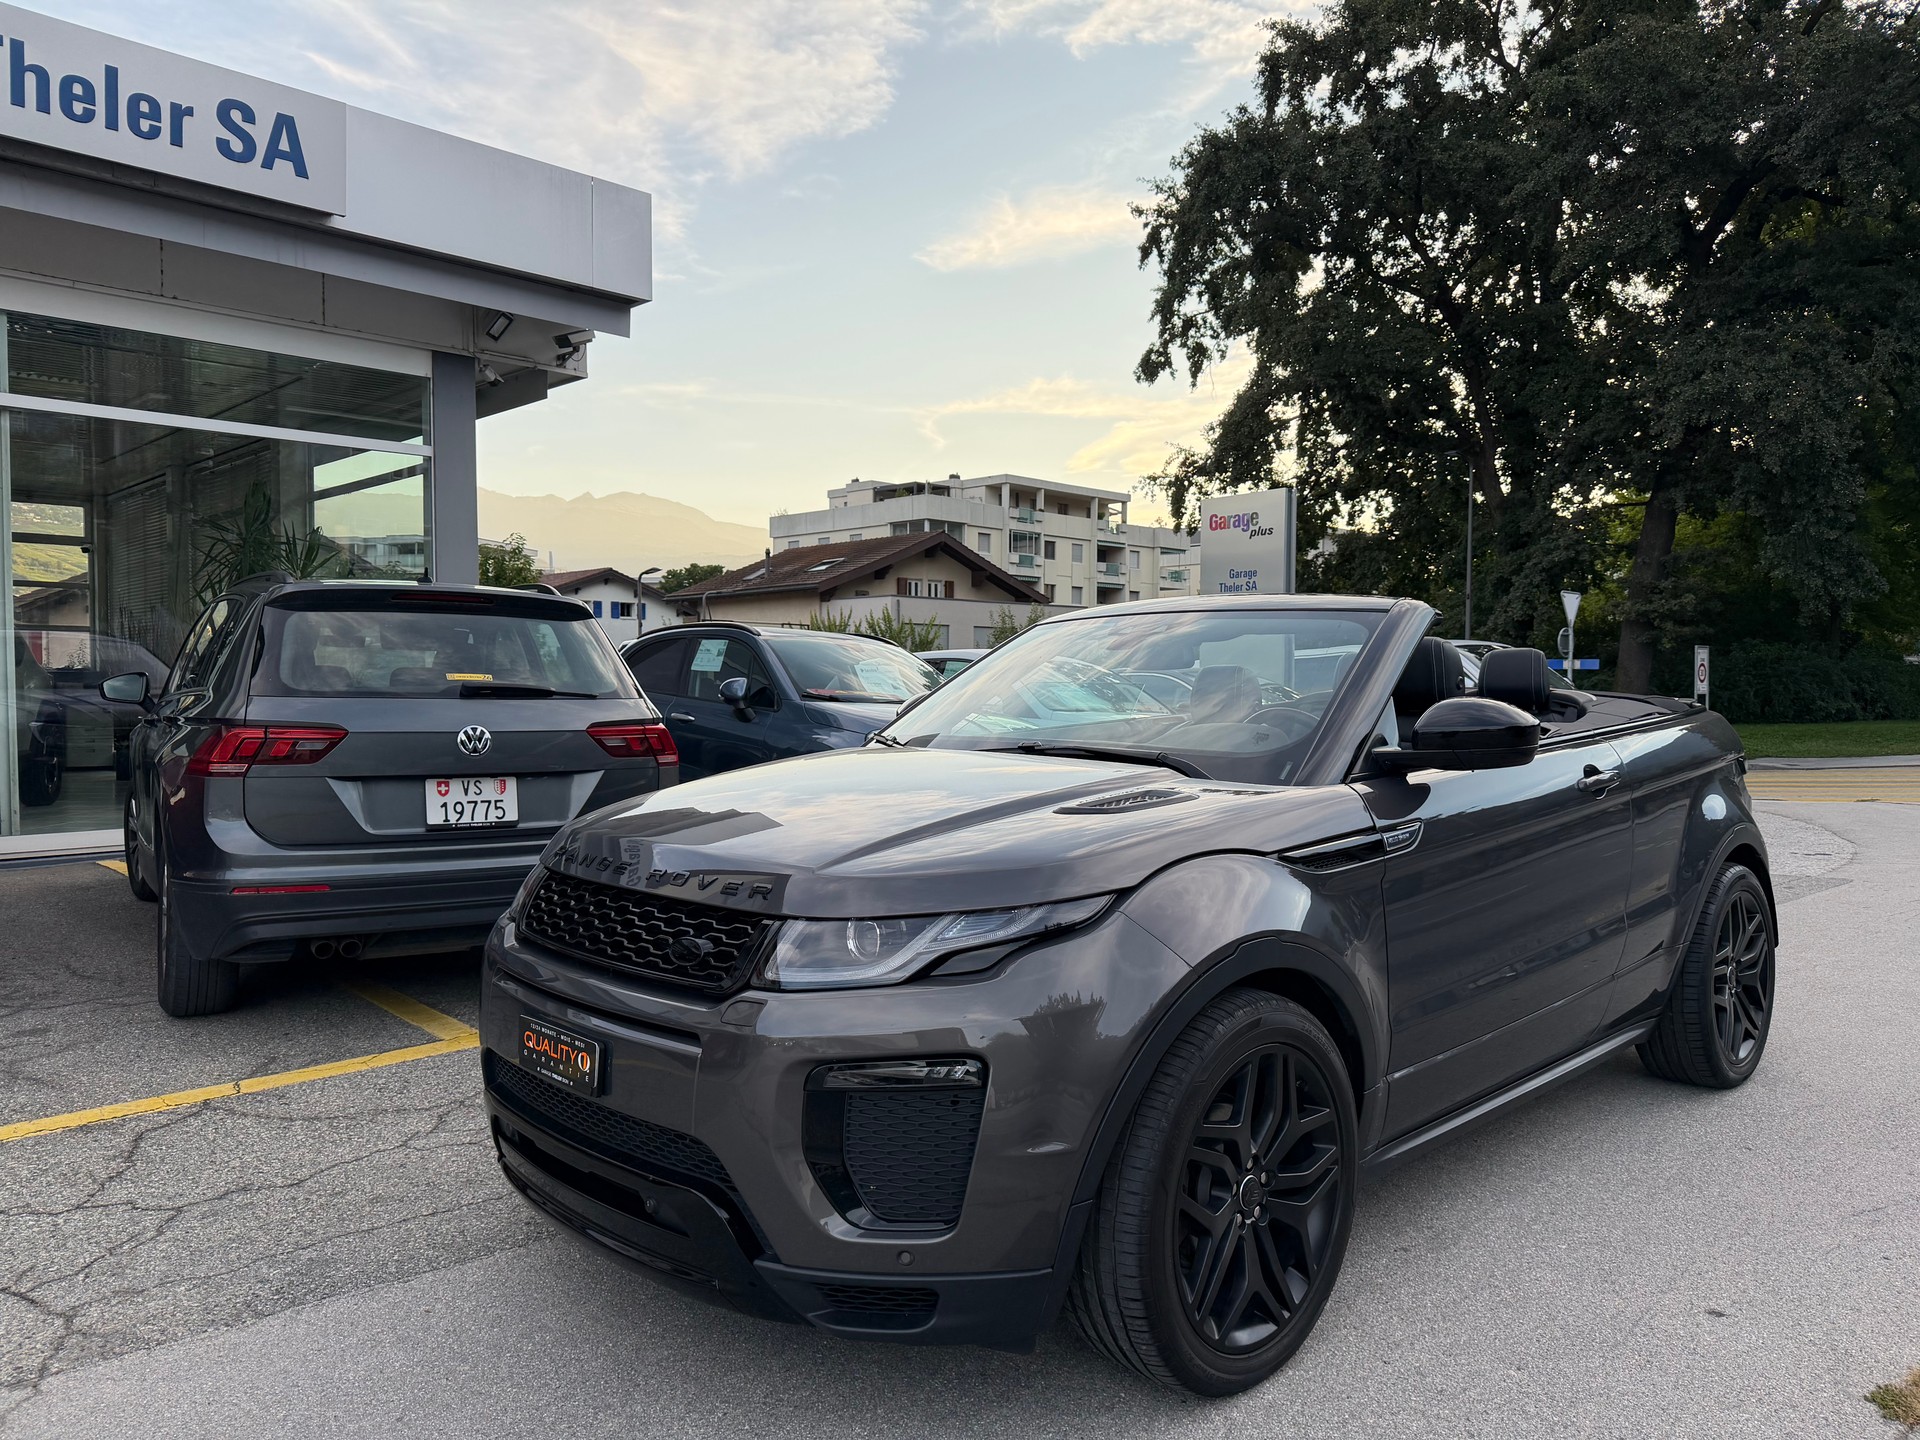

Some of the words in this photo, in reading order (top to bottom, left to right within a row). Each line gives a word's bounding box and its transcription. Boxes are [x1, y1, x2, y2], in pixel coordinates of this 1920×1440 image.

[0, 35, 194, 149] heler
[215, 98, 310, 180] SA
[1209, 511, 1260, 533] Garage
[1249, 525, 1274, 540] plus
[1229, 568, 1258, 580] Garage
[1219, 581, 1244, 593] Theler
[1245, 580, 1258, 592] SA
[461, 780, 483, 796] VS
[440, 799, 506, 823] 19775
[646, 868, 775, 901] ROVER
[524, 1031, 578, 1064] QUALITY
[523, 1049, 589, 1082] GARANTIE
